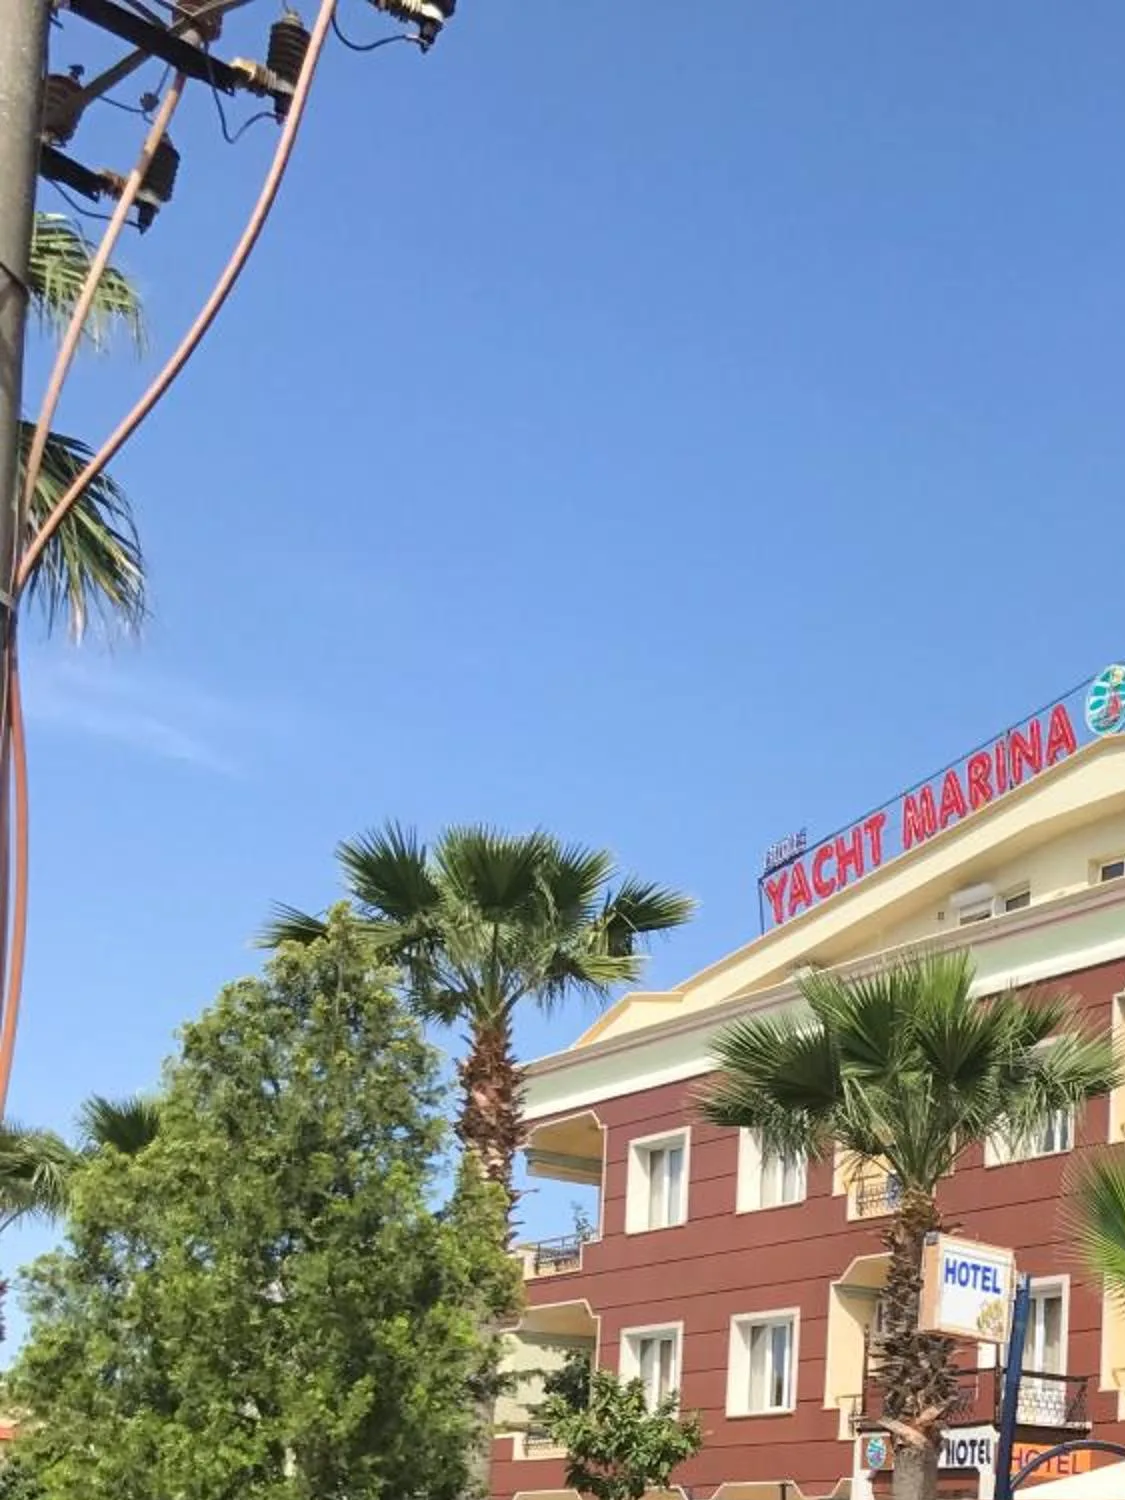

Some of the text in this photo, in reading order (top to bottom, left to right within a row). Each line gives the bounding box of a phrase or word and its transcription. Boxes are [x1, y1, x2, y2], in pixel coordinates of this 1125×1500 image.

[763, 811, 887, 925] YACHT
[902, 702, 1079, 850] MARINA
[944, 1257, 1002, 1295] HOTEL
[944, 1438, 991, 1465] HOTEL
